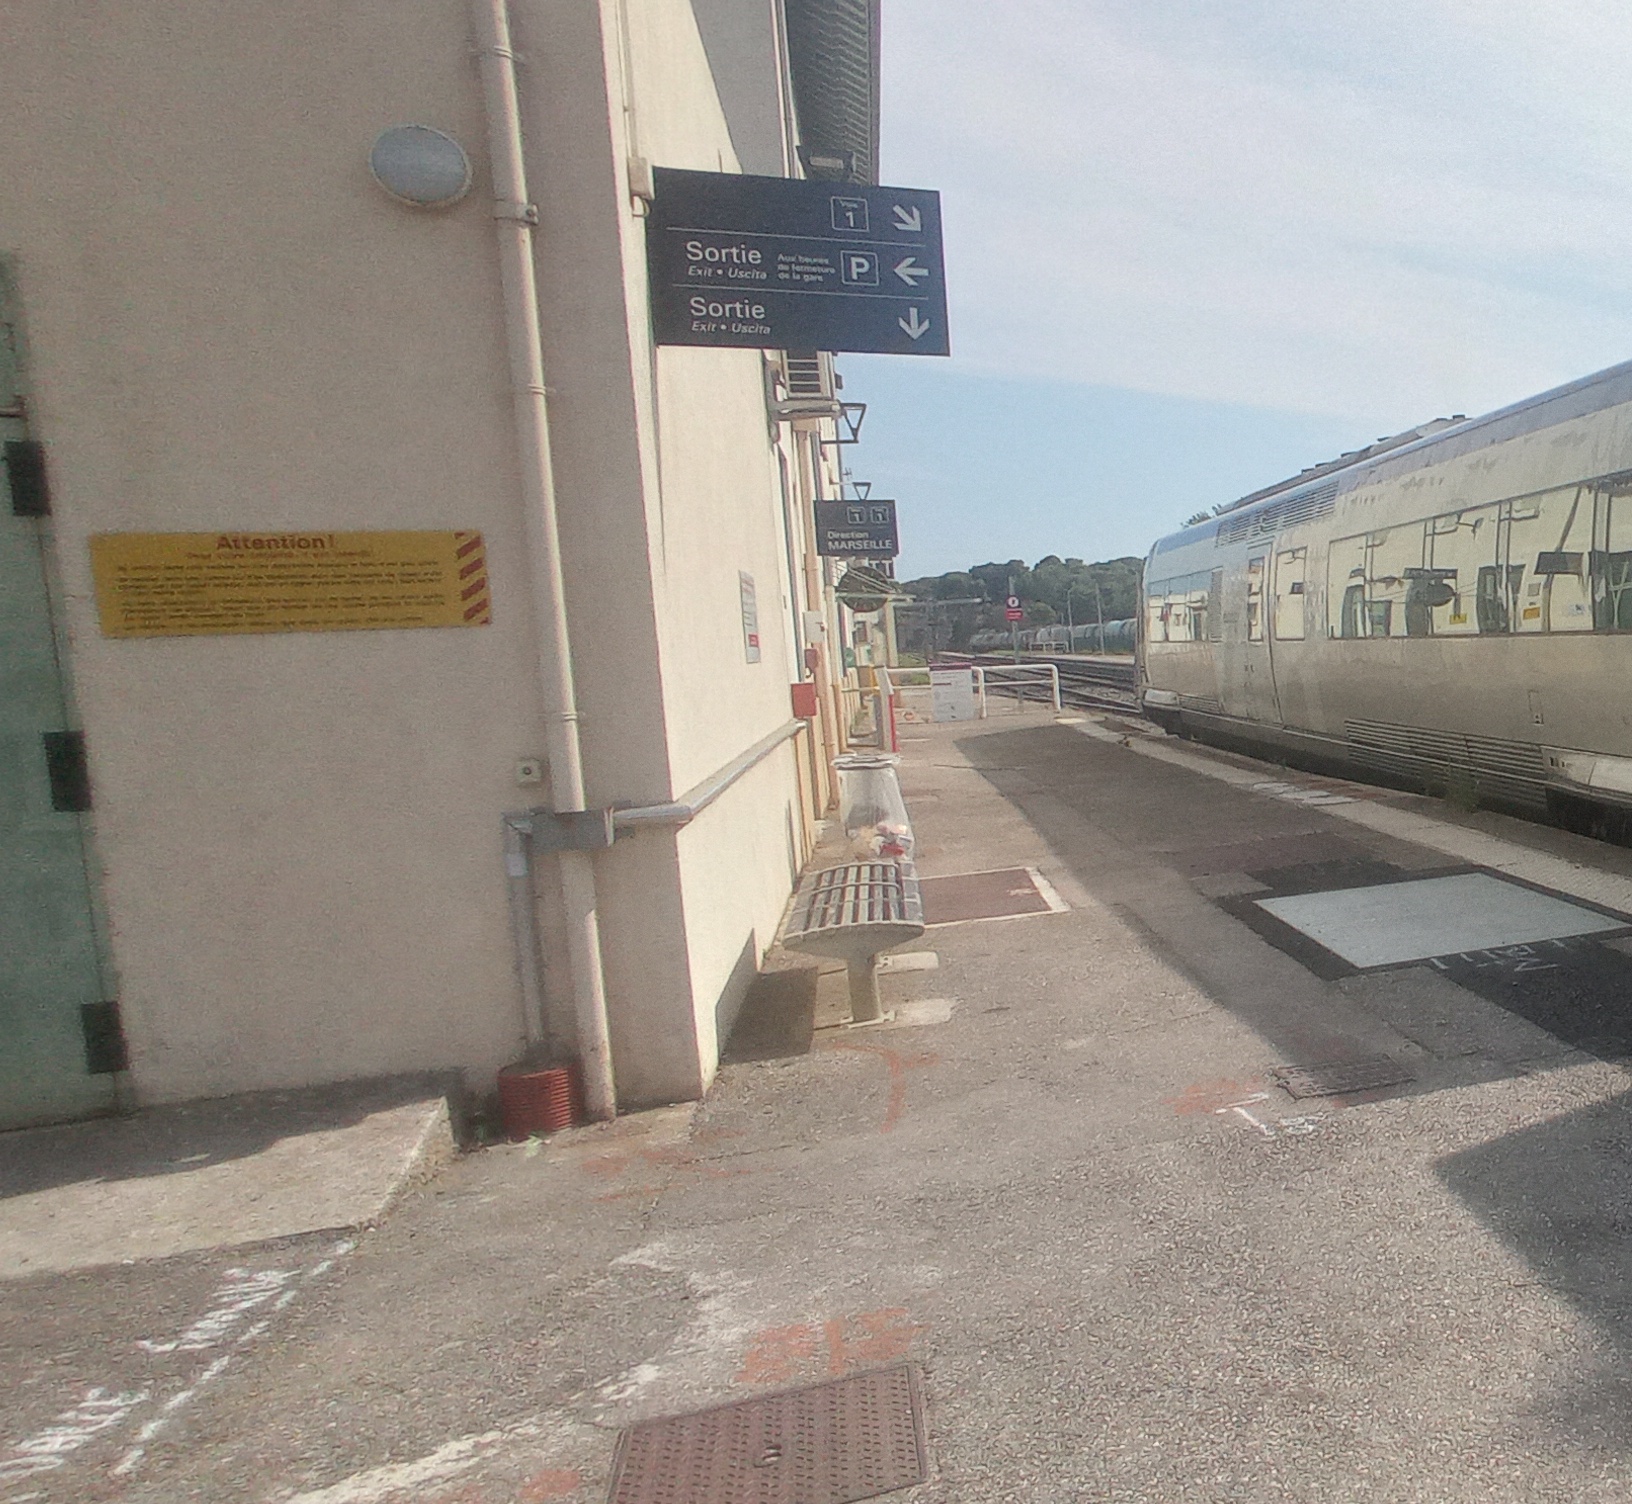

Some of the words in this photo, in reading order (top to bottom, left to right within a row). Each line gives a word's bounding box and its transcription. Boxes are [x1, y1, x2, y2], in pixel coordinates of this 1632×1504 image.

[845, 211, 855, 228] 1
[686, 241, 762, 264] Sortie
[688, 265, 713, 277] Exit
[728, 267, 767, 280] Uscita
[850, 256, 870, 280] P
[690, 297, 766, 319] Sortie
[692, 321, 717, 332] Exit
[731, 323, 771, 334] Uscita
[828, 531, 869, 540] Direction
[828, 540, 892, 550] MARSEILLE
